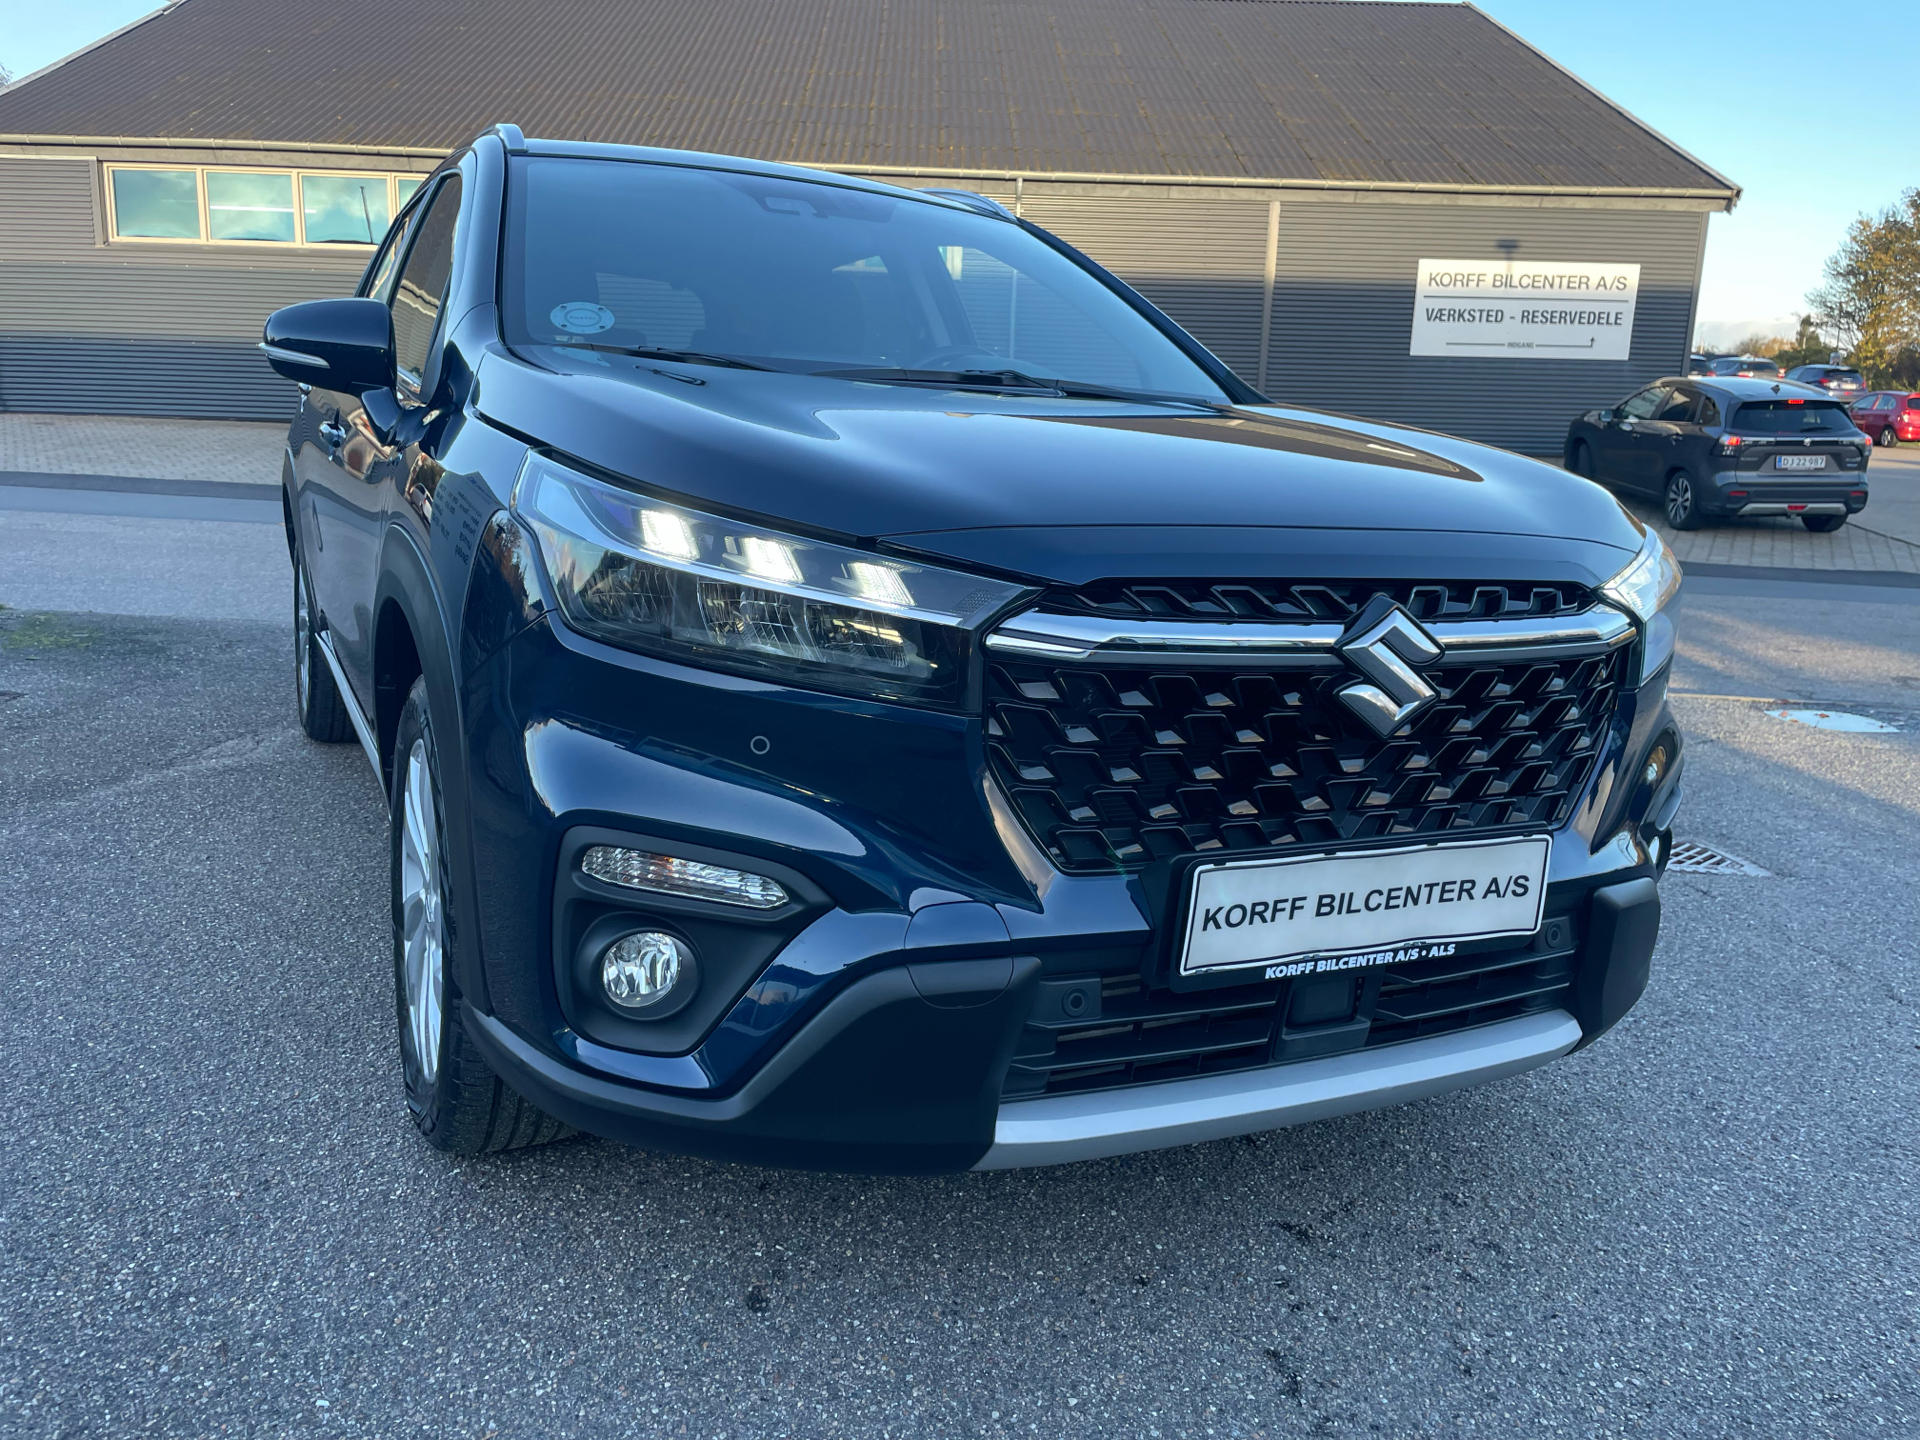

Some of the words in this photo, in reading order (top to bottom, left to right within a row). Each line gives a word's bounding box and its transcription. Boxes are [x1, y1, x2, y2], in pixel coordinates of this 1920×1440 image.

[1428, 272, 1487, 288] KORFF
[1492, 273, 1590, 290] BILCENTER
[1595, 276, 1628, 291] A/S
[1425, 307, 1504, 323] VÆRKSTED
[1521, 309, 1623, 326] RESERVEDELE
[1783, 457, 1794, 466] DJ
[1796, 457, 1806, 466] 22
[1808, 456, 1824, 466] 987
[1202, 896, 1307, 932] KORFF
[1314, 878, 1477, 917] BILCENTER
[1482, 874, 1530, 900] A/S
[1264, 961, 1314, 980] KORFF
[1315, 952, 1394, 973] BILCENTER
[1395, 948, 1419, 963] A/S
[1428, 944, 1456, 958] ALS
